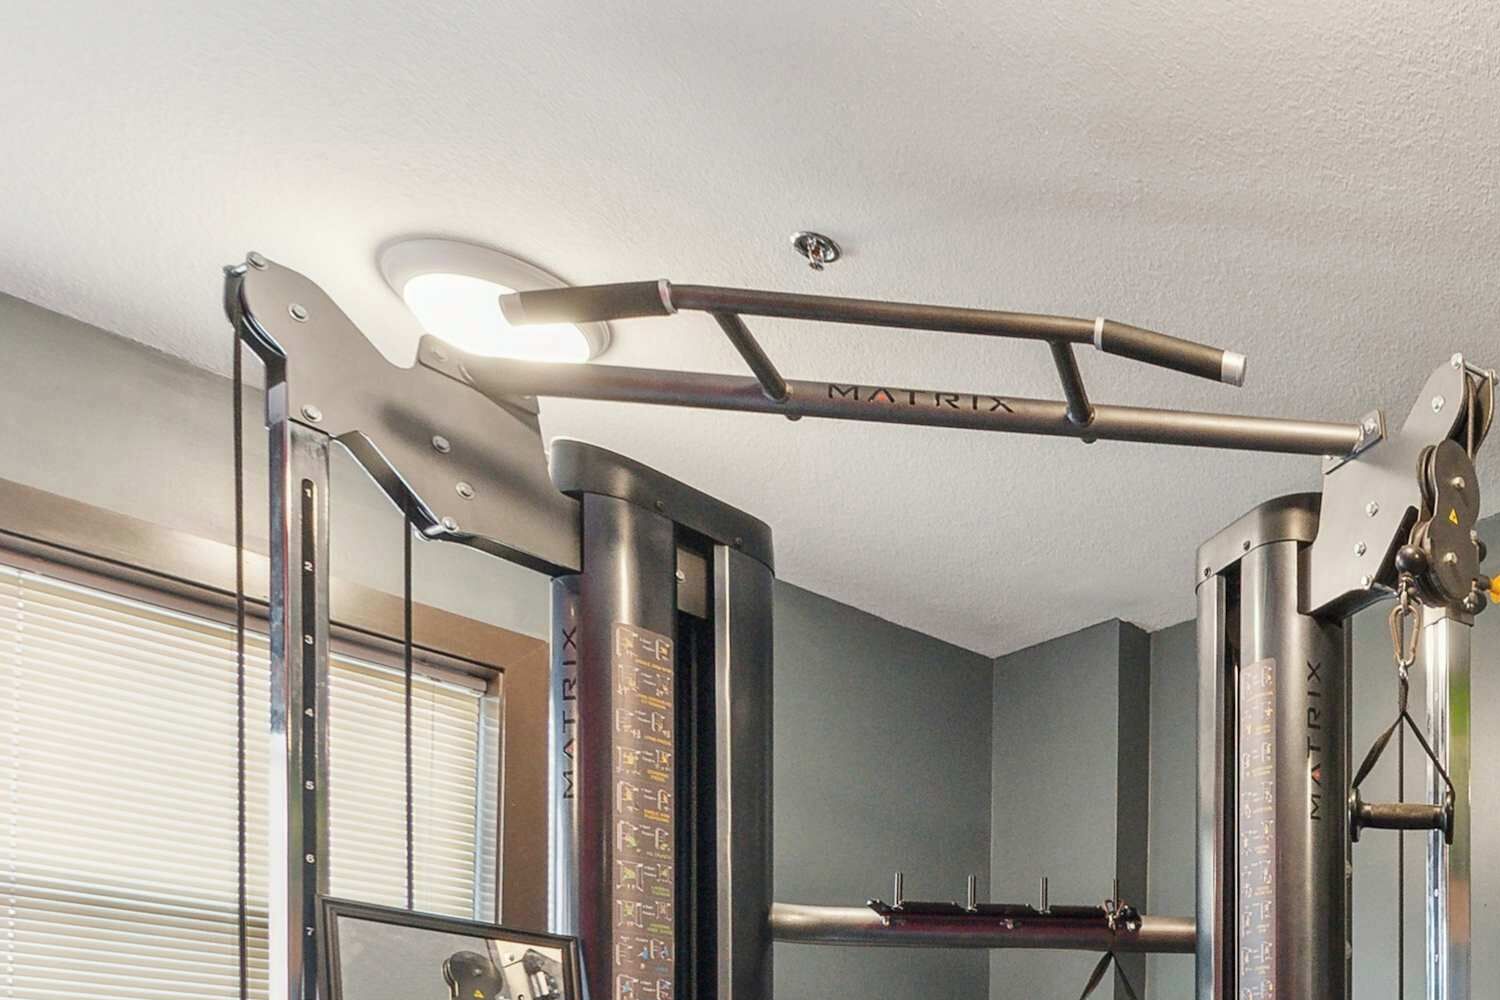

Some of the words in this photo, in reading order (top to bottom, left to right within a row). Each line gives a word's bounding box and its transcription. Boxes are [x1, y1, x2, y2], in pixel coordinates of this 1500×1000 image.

[828, 384, 1014, 413] MATRIX
[304, 488, 312, 498] 1
[304, 561, 313, 572] 2
[304, 634, 314, 645] 3
[304, 707, 314, 717] 4
[562, 625, 577, 800] MATRIX
[1306, 659, 1321, 821] MATRIX
[305, 780, 315, 790] 5
[305, 854, 315, 863] 6
[306, 927, 315, 936] 7
